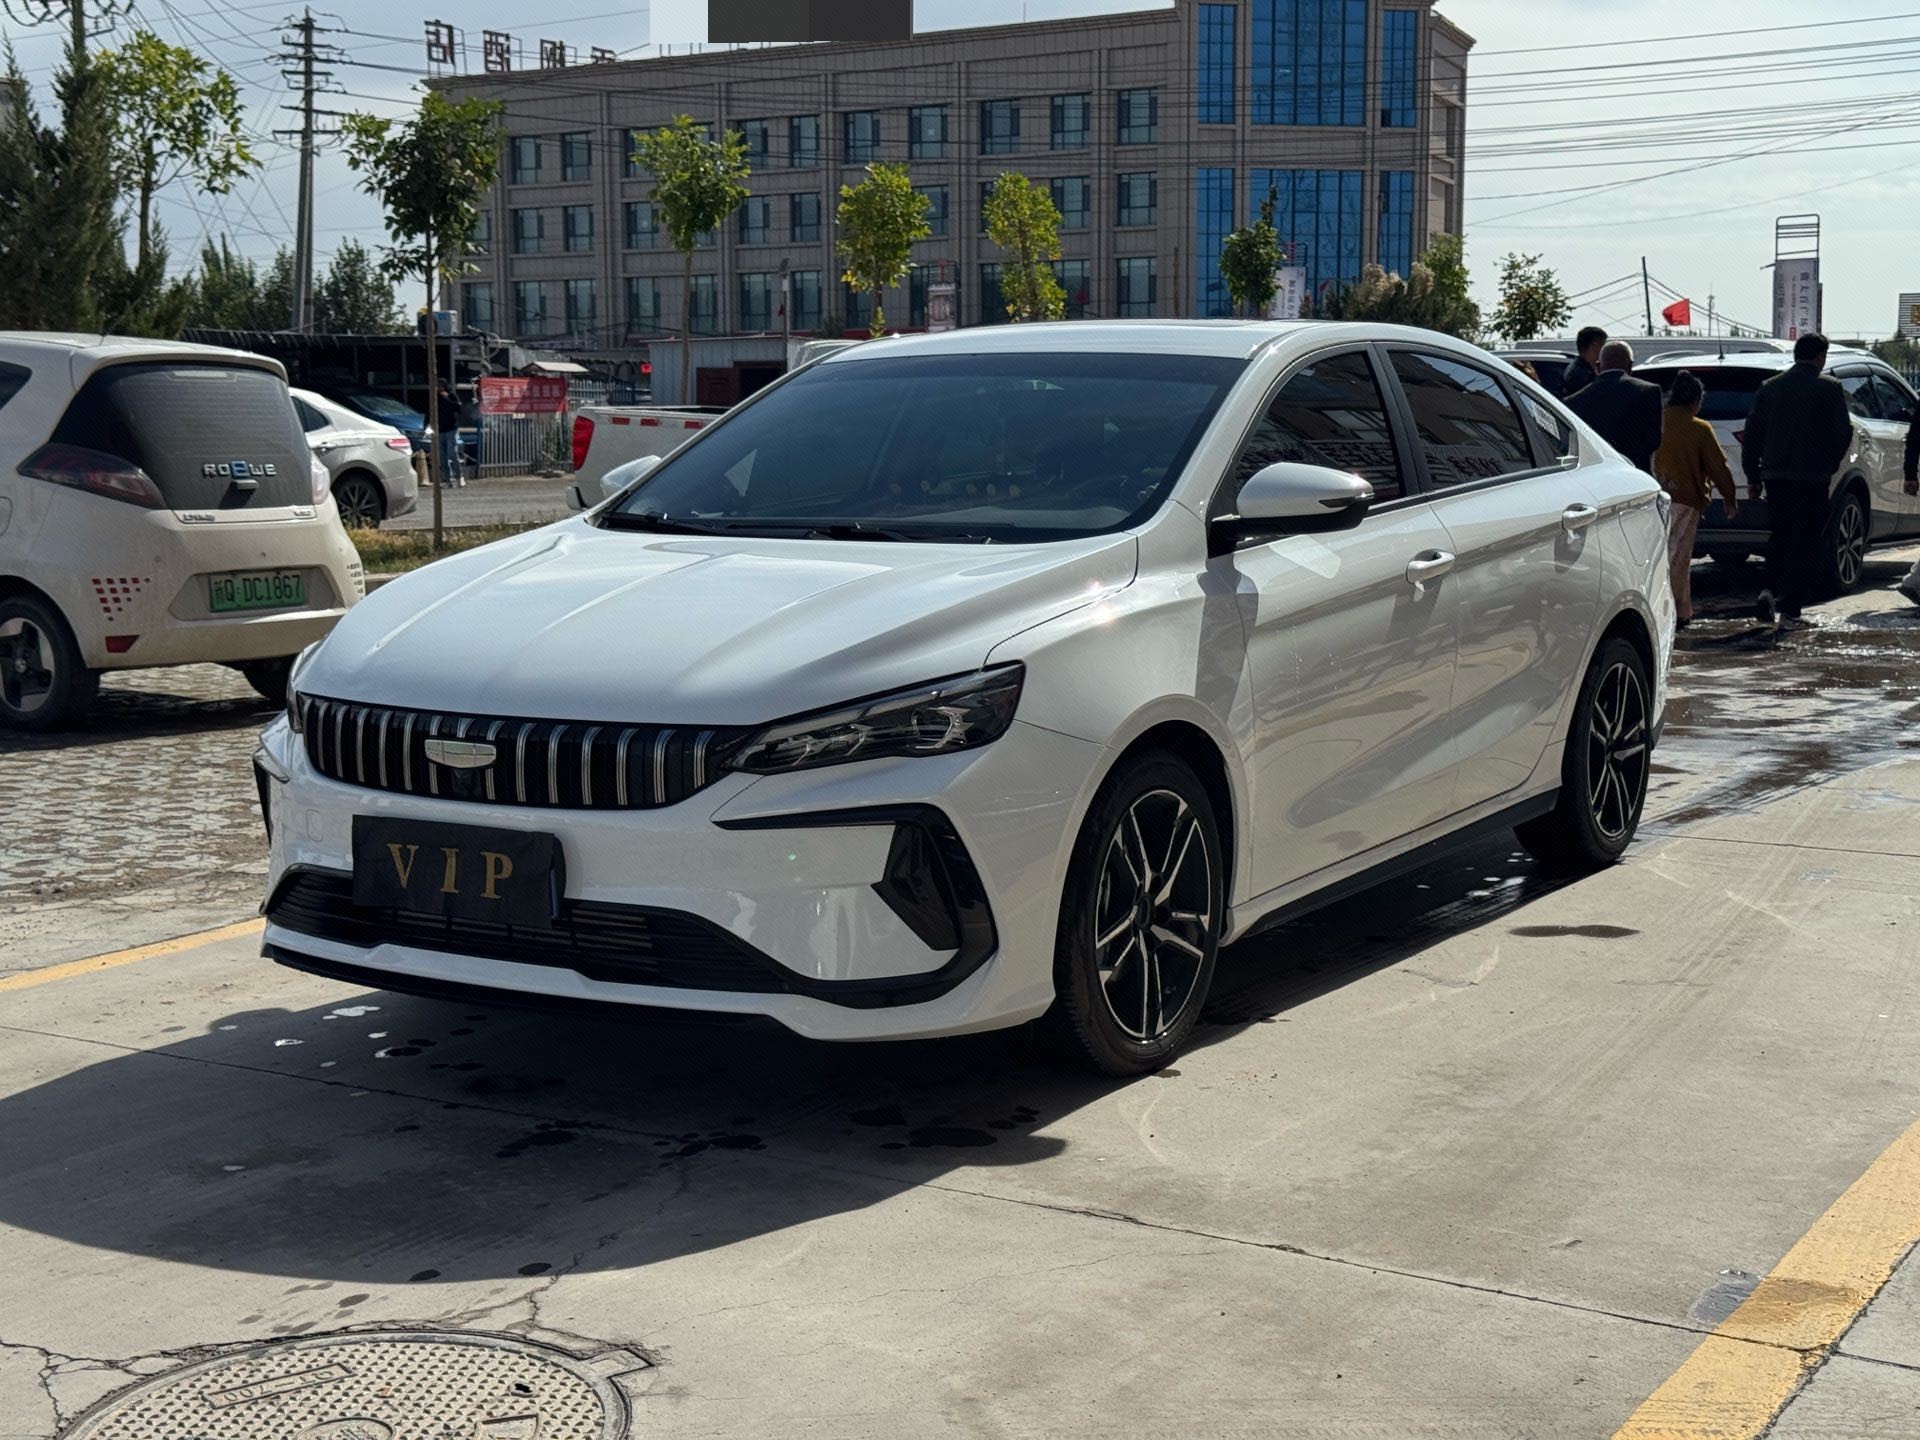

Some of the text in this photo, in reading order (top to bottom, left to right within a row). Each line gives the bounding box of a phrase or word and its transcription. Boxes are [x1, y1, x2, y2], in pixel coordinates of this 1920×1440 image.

[203, 460, 278, 479] ROEWE
[242, 574, 301, 602] DC1867
[386, 843, 514, 899] VIP
